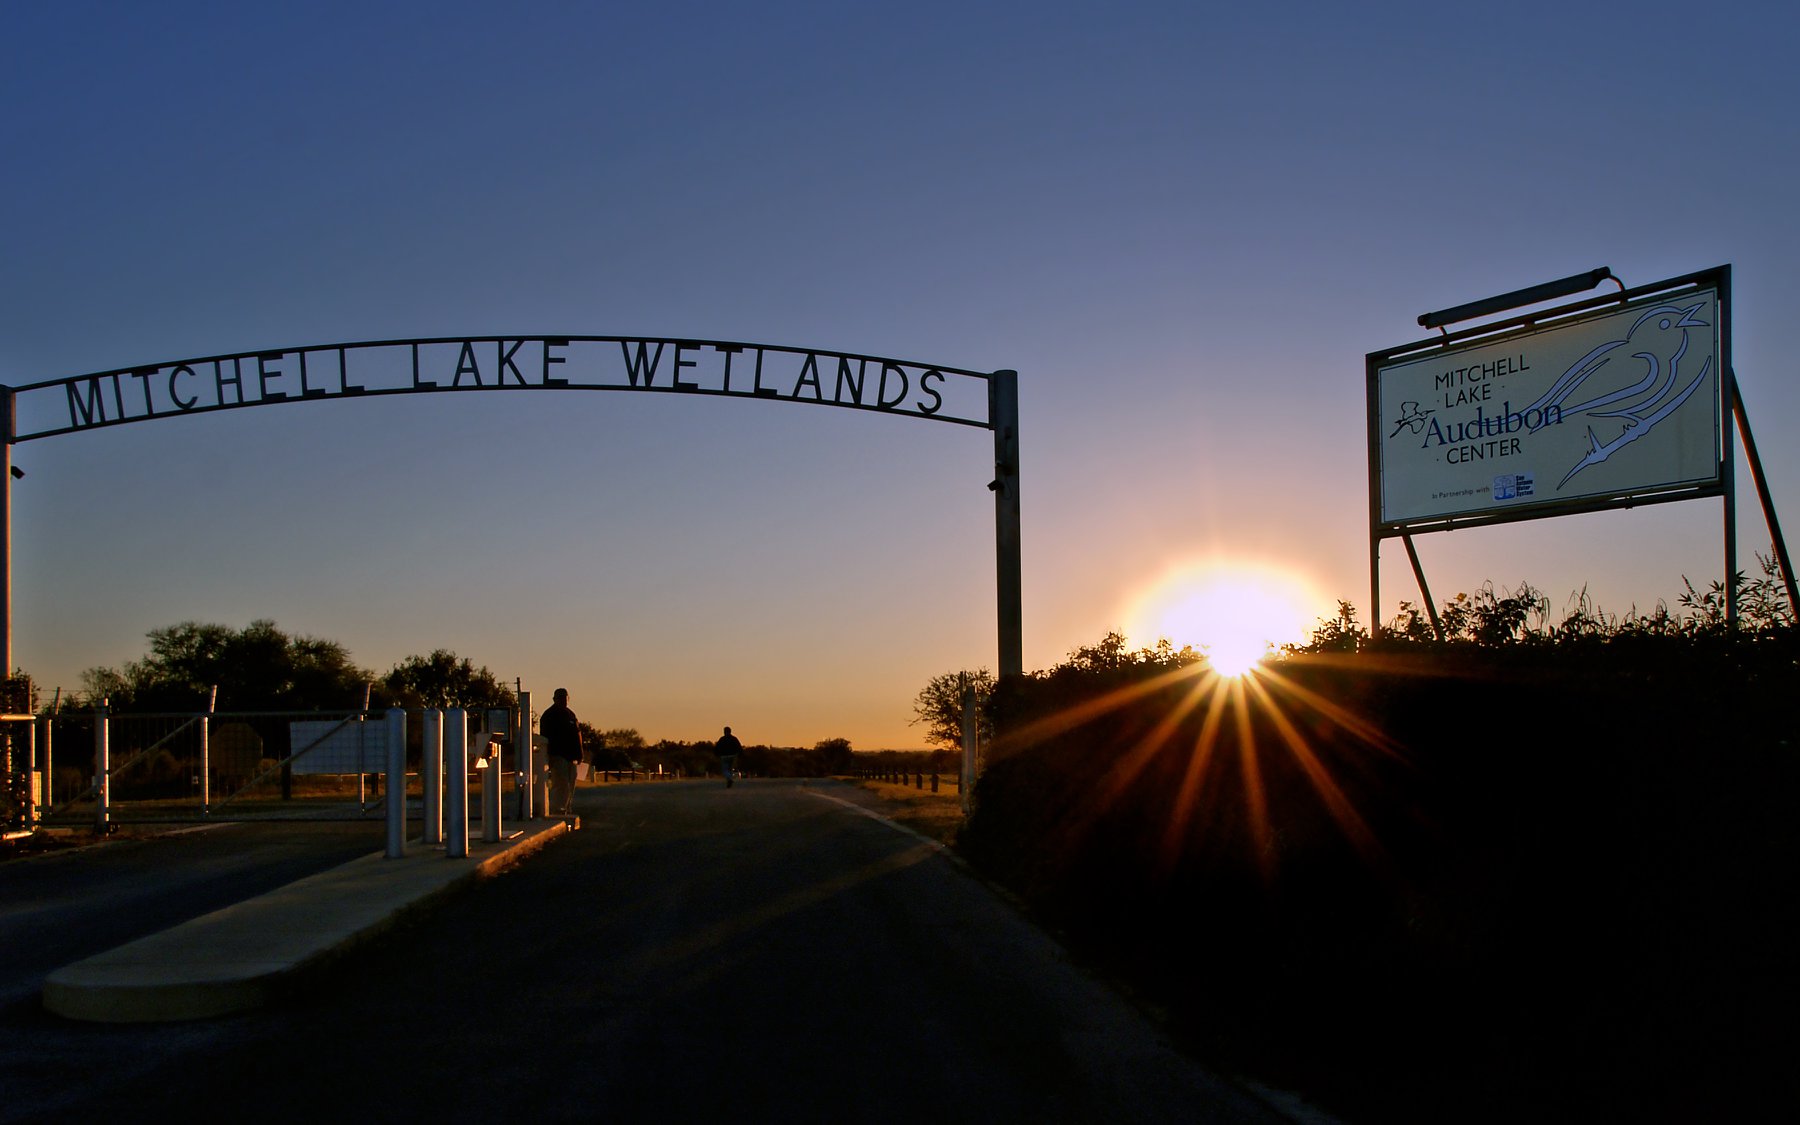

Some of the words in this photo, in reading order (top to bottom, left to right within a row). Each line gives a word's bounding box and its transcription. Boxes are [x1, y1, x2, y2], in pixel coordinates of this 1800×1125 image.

[66, 346, 364, 427] MITCHELL
[413, 340, 569, 388] LAKE
[621, 340, 947, 416] WETLANDS
[1435, 355, 1530, 390] MITCHELL
[1445, 383, 1492, 408] LAKE
[1421, 401, 1564, 449] Audubon
[1446, 438, 1521, 464] CENTER
[1439, 490, 1473, 498] Partnership
